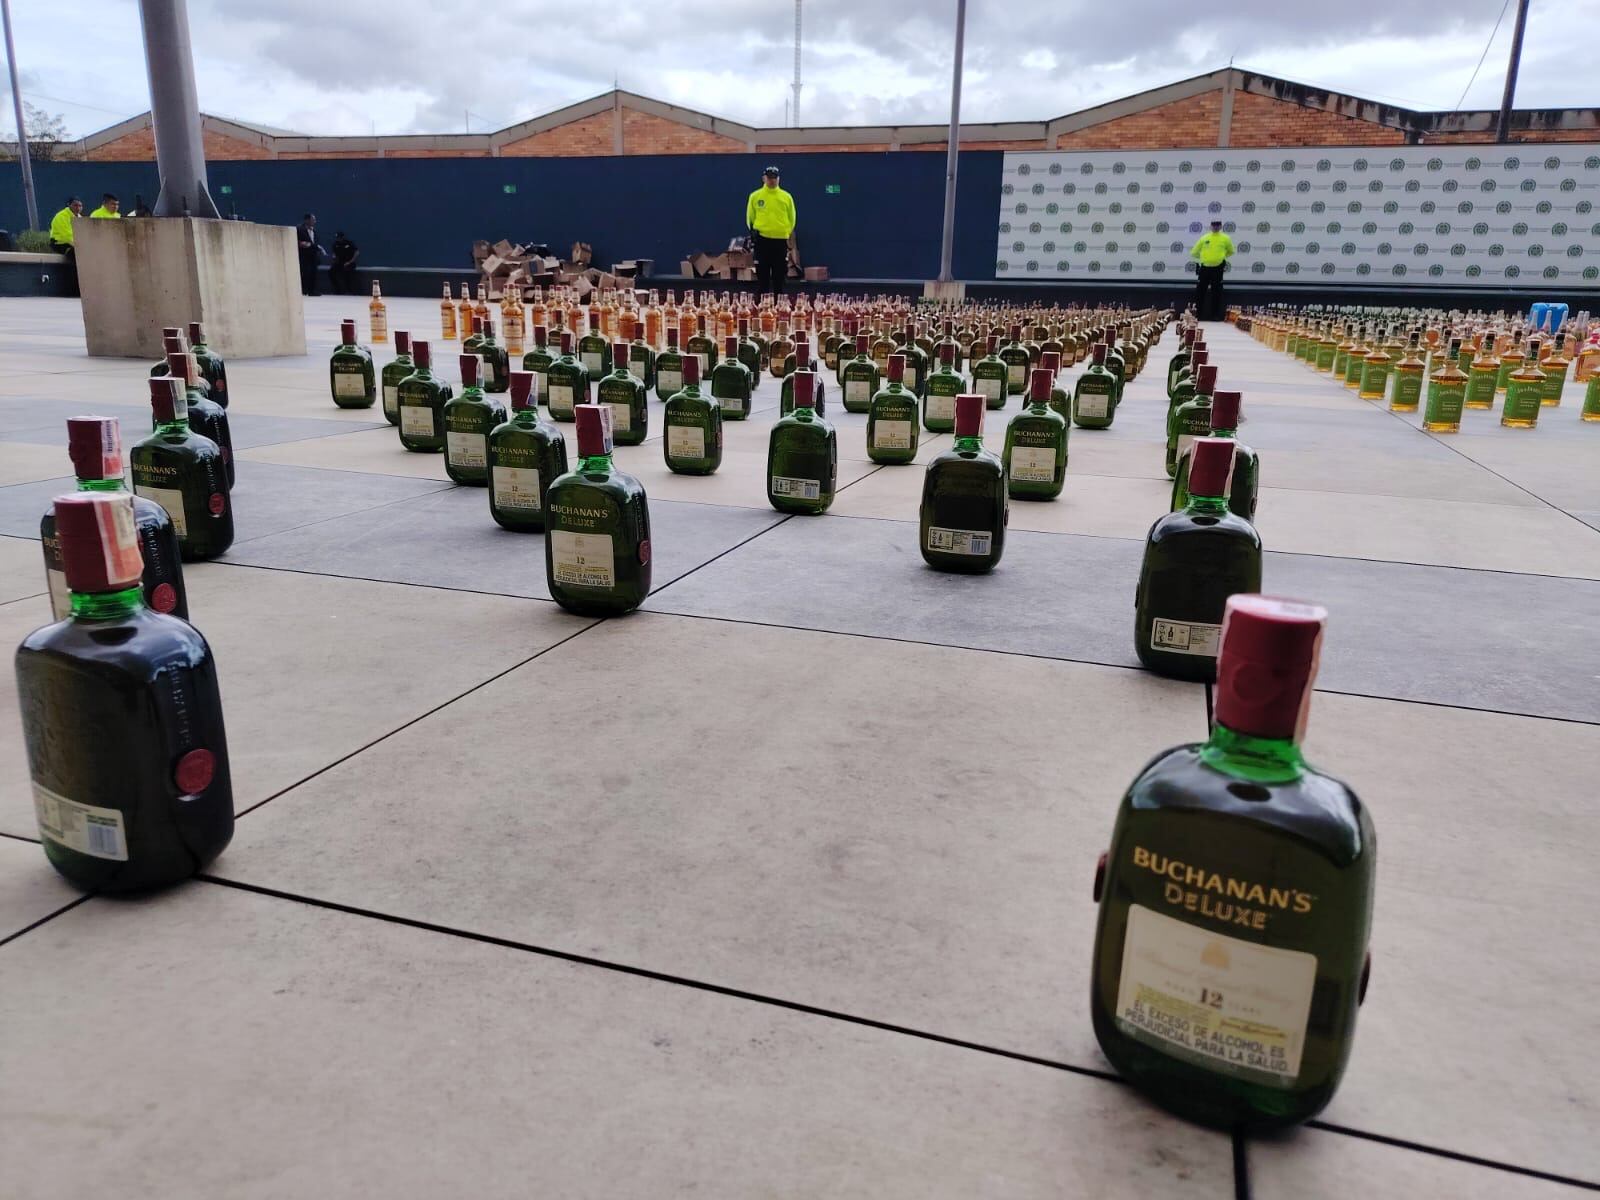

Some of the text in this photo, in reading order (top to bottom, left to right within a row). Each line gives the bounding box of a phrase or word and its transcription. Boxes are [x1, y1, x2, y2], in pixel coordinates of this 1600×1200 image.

[550, 503, 609, 519] BUCHANAN'S
[561, 515, 595, 528] DELUXE
[1133, 846, 1312, 913] BUCHANAN'S
[1164, 882, 1267, 930] DELUXE
[1200, 988, 1224, 1009] 12
[1124, 1008, 1191, 1047] PERJUDICIAL
[1194, 1037, 1226, 1058] PARA
[1228, 1050, 1244, 1062] LA
[1133, 1000, 1286, 1058] EL EXCESO DE ALCOHOL ES
